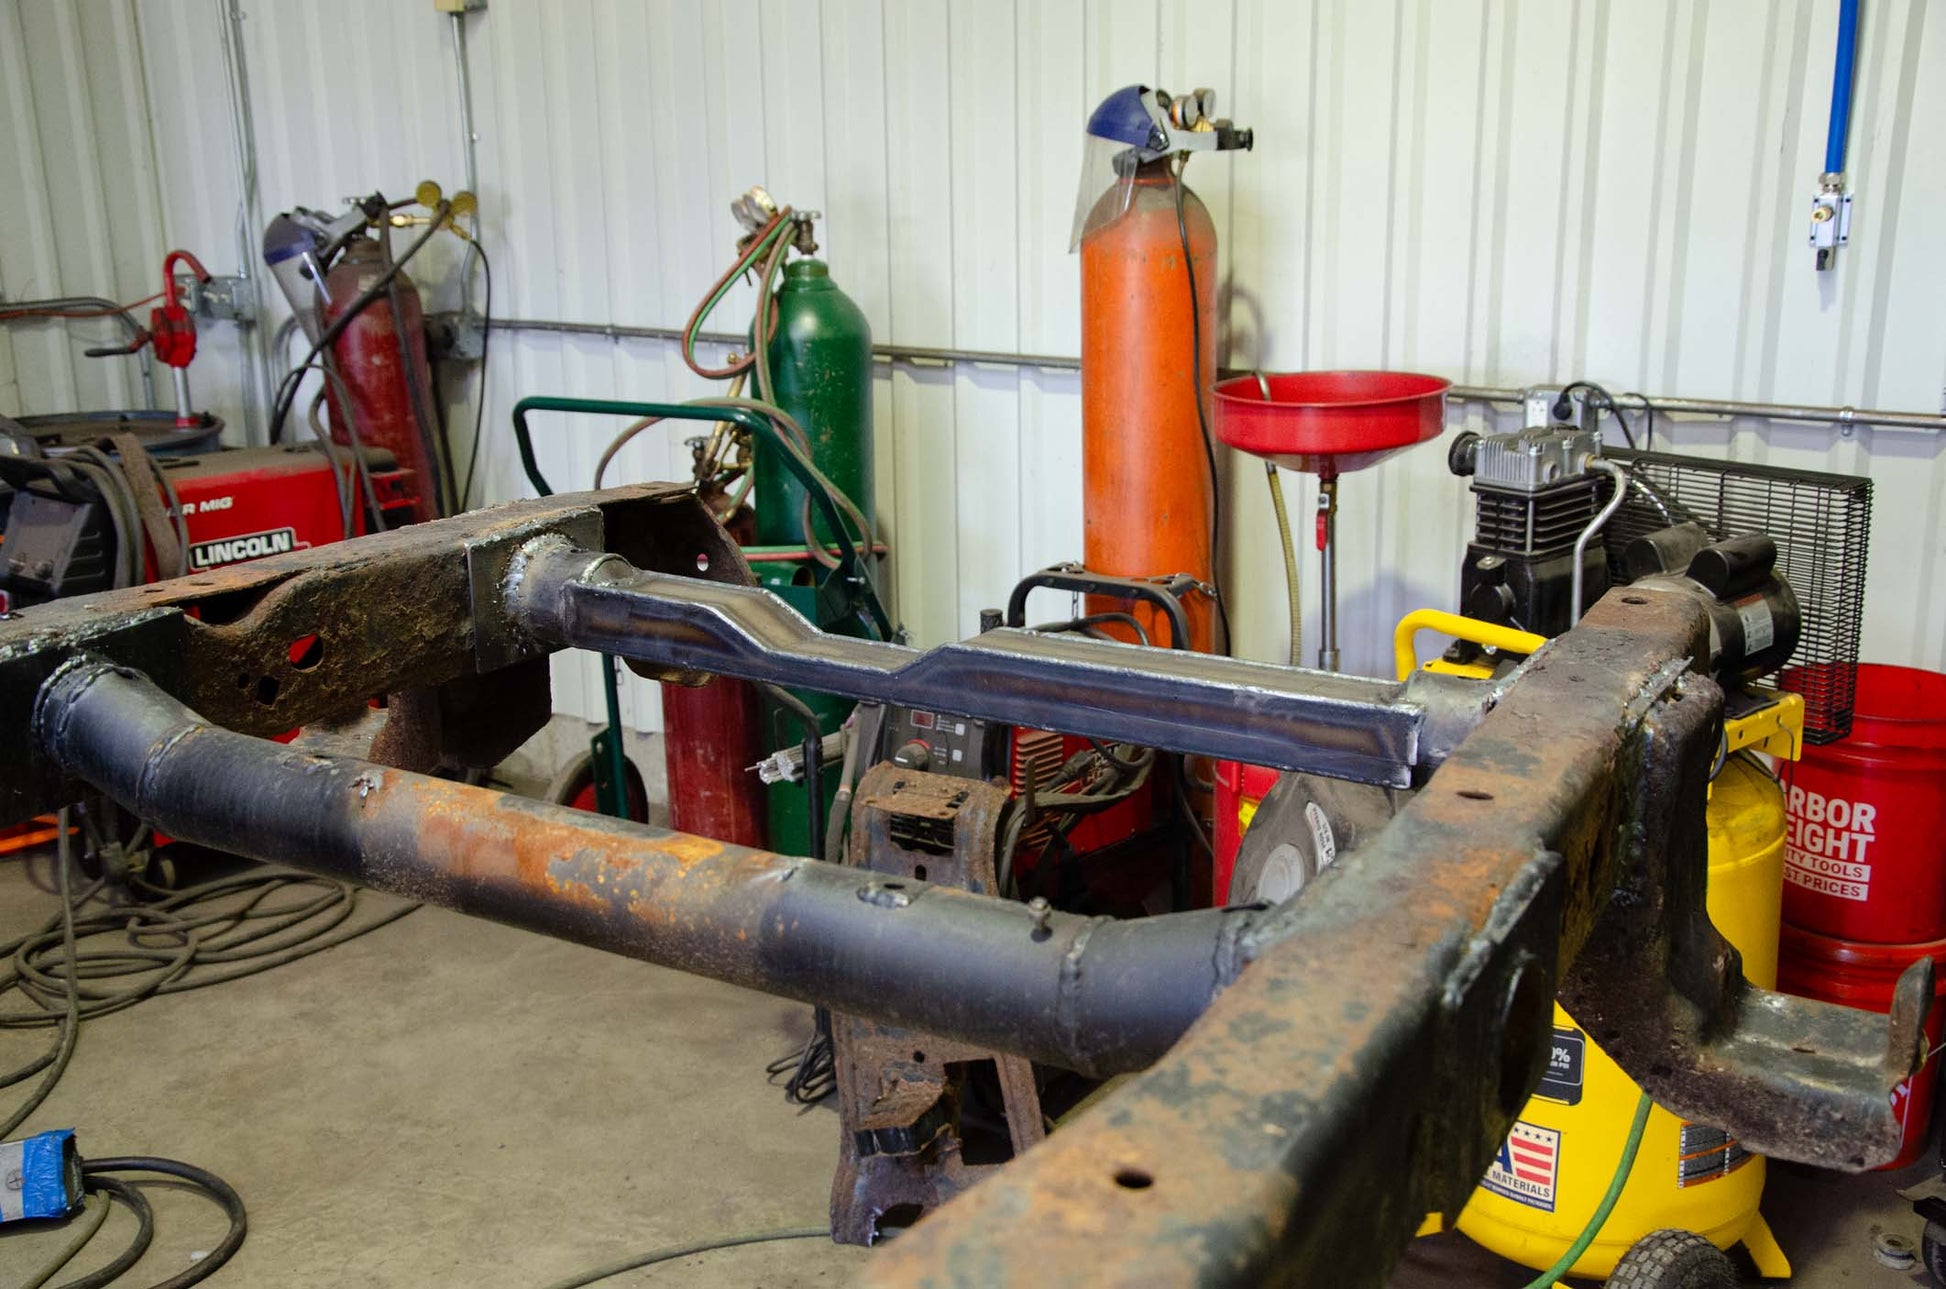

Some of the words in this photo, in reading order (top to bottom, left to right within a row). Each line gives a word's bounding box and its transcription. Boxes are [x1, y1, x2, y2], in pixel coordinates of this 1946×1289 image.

[200, 497, 232, 512] MIG
[195, 532, 290, 566] LINCOLN
[1810, 856, 1864, 878] TOOLS
[1803, 874, 1862, 897] PRICES
[1492, 1170, 1551, 1198] MATERIALS
